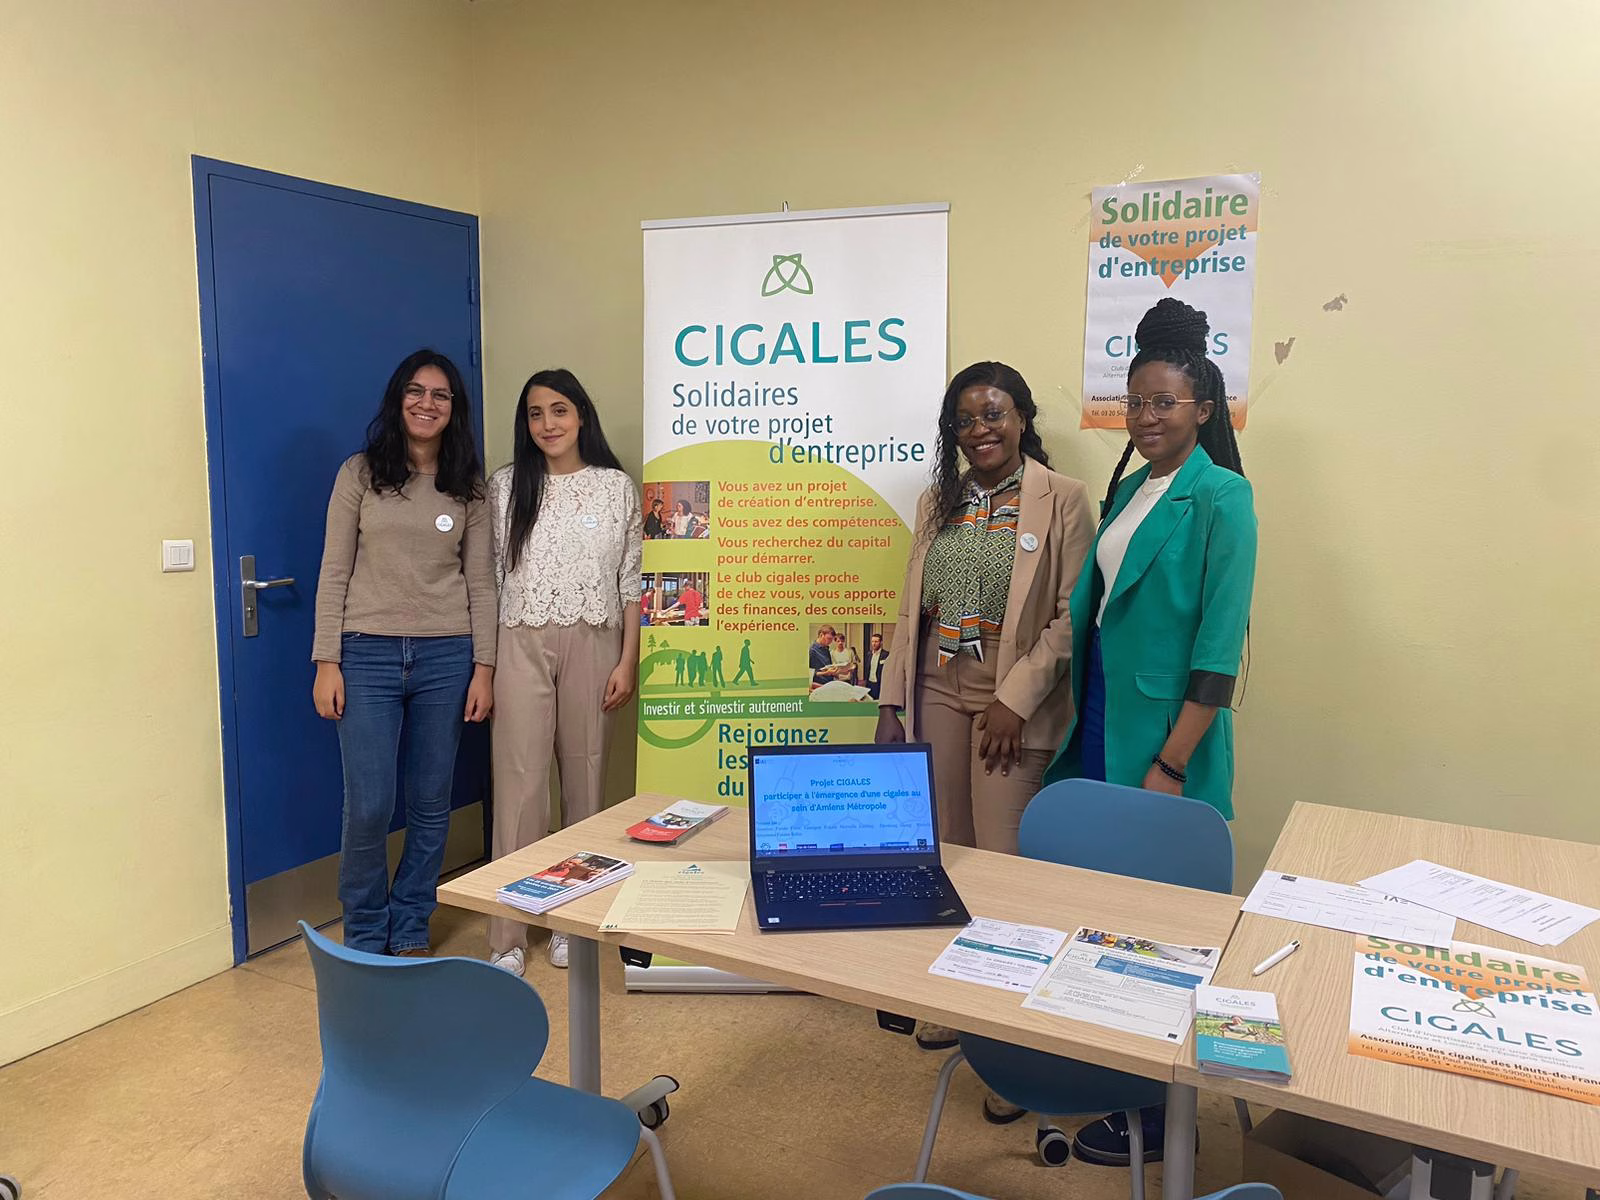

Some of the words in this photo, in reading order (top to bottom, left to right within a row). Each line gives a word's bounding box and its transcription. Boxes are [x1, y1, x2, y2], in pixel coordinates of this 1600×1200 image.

[1102, 188, 1249, 225] Solidaire
[1100, 232, 1122, 249] de
[1128, 229, 1179, 247] votre
[1186, 224, 1247, 247] projet
[1099, 251, 1246, 280] d'entreprise
[675, 318, 907, 367] CIGALES
[673, 381, 798, 407] Solidaires
[672, 414, 697, 435] de
[706, 418, 759, 434] votre
[769, 412, 832, 439] projet
[769, 437, 924, 469] d'entreprise
[718, 481, 749, 492] Vous
[752, 482, 783, 492] avez
[786, 482, 803, 491] un
[807, 481, 847, 494] projet
[718, 497, 733, 508] de
[738, 497, 790, 508] création
[795, 496, 877, 510] d'entreprise.
[718, 517, 749, 528] Vous
[752, 518, 783, 527] avez
[786, 517, 809, 527] des
[813, 517, 901, 530] compétences.
[718, 537, 748, 547] Vous
[752, 536, 822, 547] recherchez
[827, 536, 843, 547] du
[848, 536, 890, 549] capital
[718, 554, 748, 566] pour
[752, 553, 814, 564] démarrer.
[717, 572, 731, 583] Le
[736, 572, 762, 583] club
[766, 572, 810, 585] cigales
[814, 572, 859, 585] proche
[717, 588, 733, 599] de
[737, 588, 767, 599] chez
[771, 589, 804, 600] vous,
[809, 589, 840, 599] vous
[844, 589, 896, 601] apporte
[717, 604, 739, 615] des
[743, 604, 800, 616] finances,
[805, 604, 827, 615] des
[832, 604, 886, 616] conseils,
[717, 620, 799, 633] l'expérience.
[644, 702, 680, 715] Investir
[685, 703, 695, 715] et
[699, 701, 745, 715] s'investir
[749, 700, 803, 713] autrement
[719, 724, 829, 747] Rejoignez
[719, 750, 748, 769] les
[718, 775, 744, 796] du
[810, 779, 834, 788] Projet
[837, 778, 870, 786] CIGALES
[764, 792, 801, 801] participer
[812, 791, 858, 800] l'émergence
[884, 790, 908, 798] cigales
[792, 804, 807, 812] sein
[810, 803, 844, 811] d'Amiens
[847, 802, 886, 811] Métropole
[1368, 936, 1580, 984] Solidaire
[1365, 952, 1398, 964] de
[1408, 960, 1484, 980] votre
[1494, 975, 1588, 998] projet
[1364, 966, 1592, 1016] d'entreprise
[1216, 998, 1256, 1006] CIGALES
[1380, 1006, 1582, 1057] CIGALES
[1360, 1034, 1422, 1050] Association
[1426, 1046, 1446, 1055] des
[1448, 1051, 1487, 1064] cigales
[1491, 1060, 1511, 1068] des
